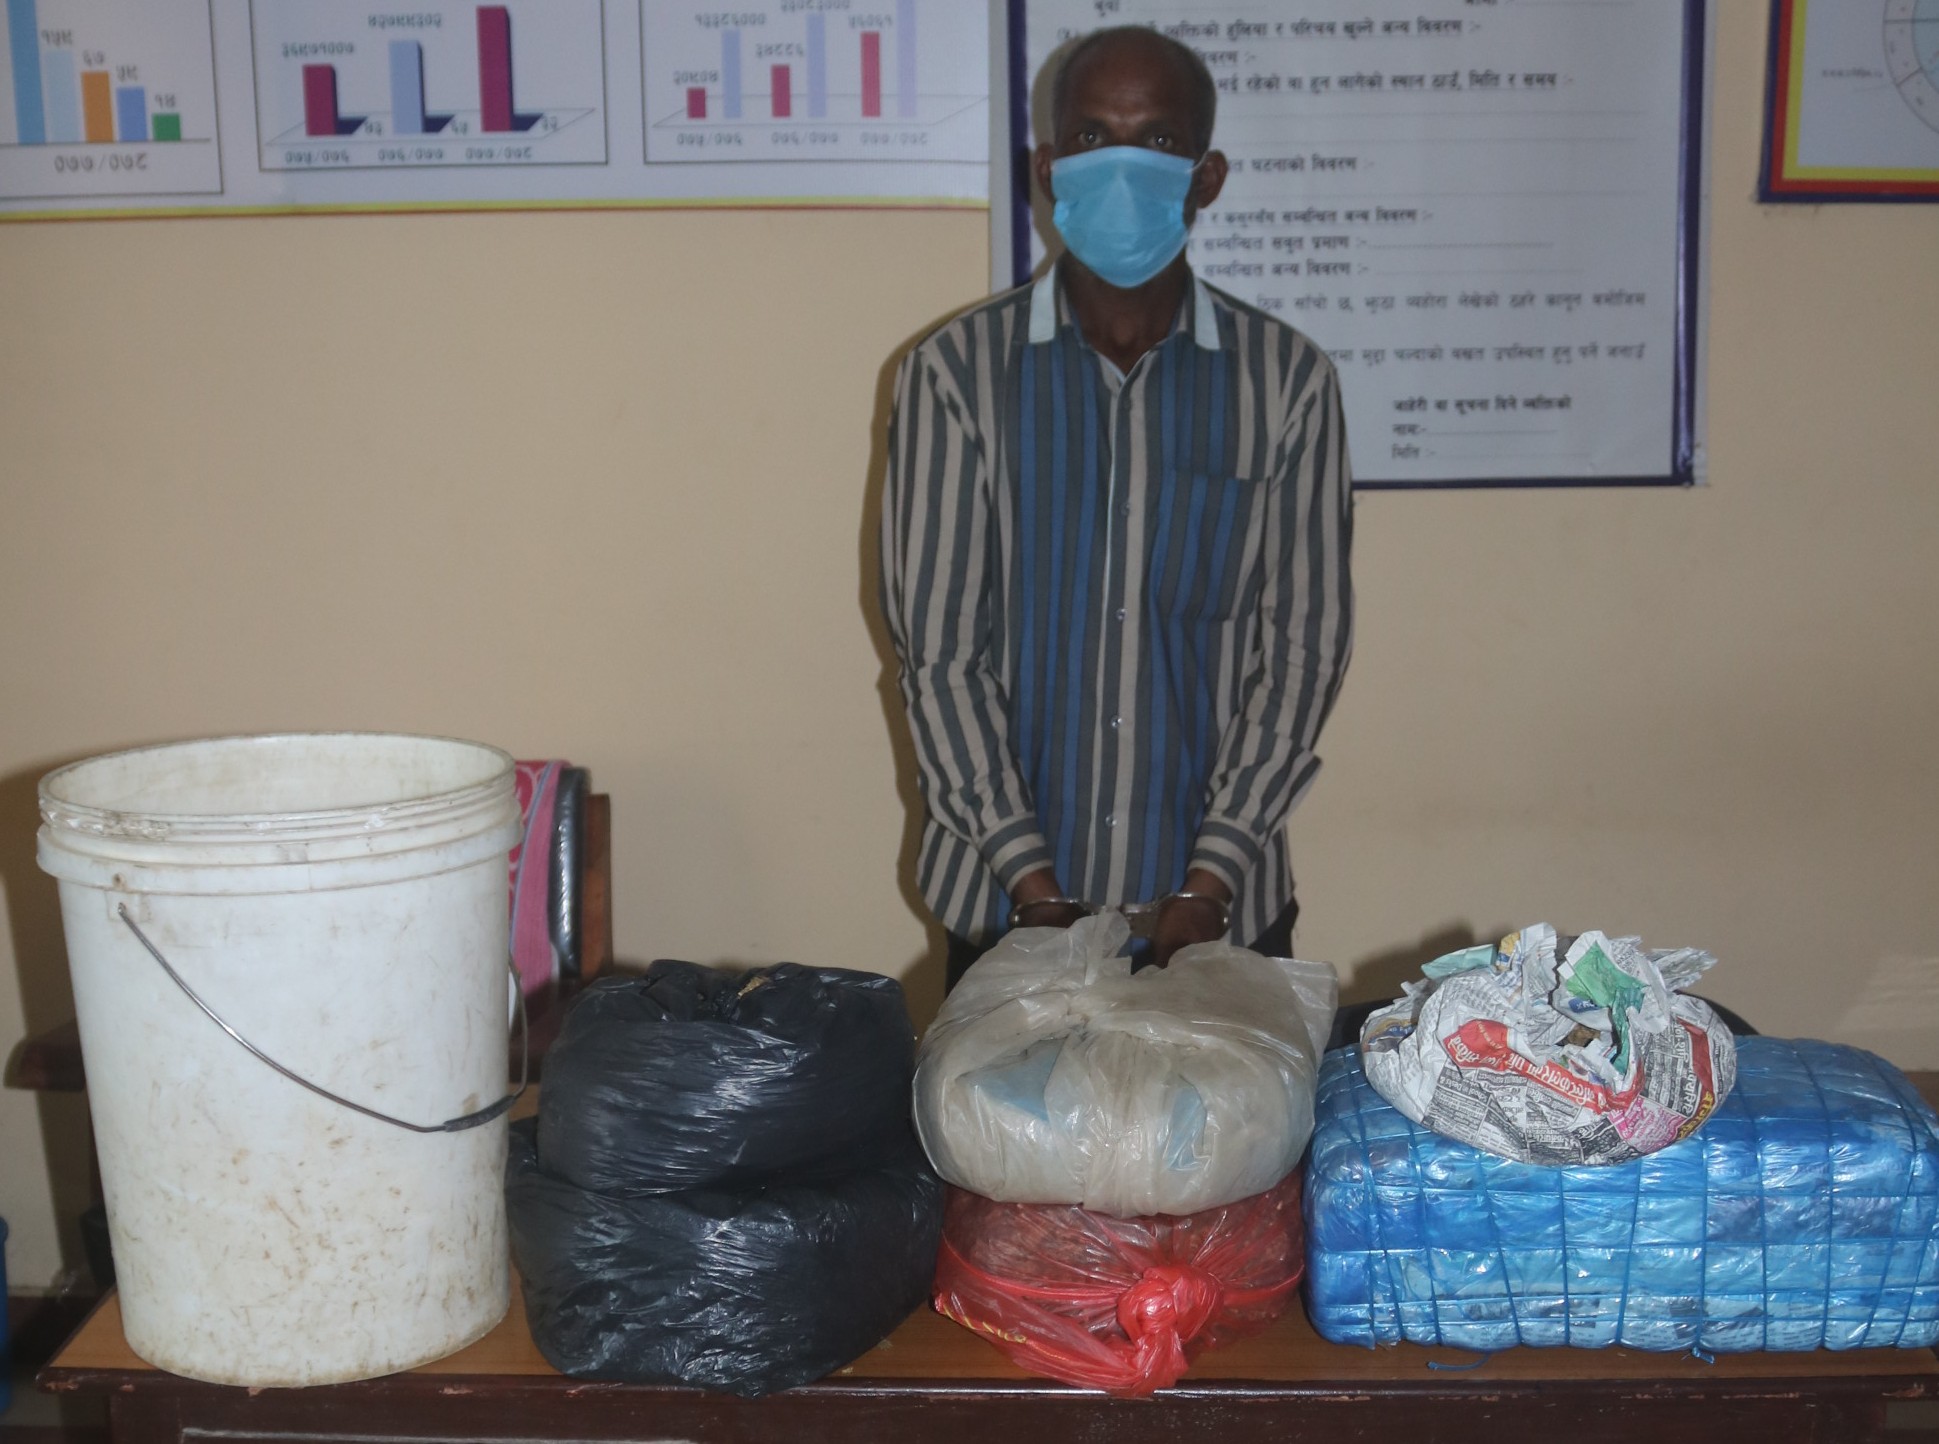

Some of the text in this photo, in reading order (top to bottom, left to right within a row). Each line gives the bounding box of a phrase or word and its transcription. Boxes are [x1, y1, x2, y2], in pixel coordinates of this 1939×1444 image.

[1416, 16, 1462, 33] विवरण
[1252, 155, 1303, 171] घटनाको
[1312, 153, 1357, 171] विवरण
[1376, 206, 1417, 221] विवरण
[1306, 258, 1351, 275] विवरण
